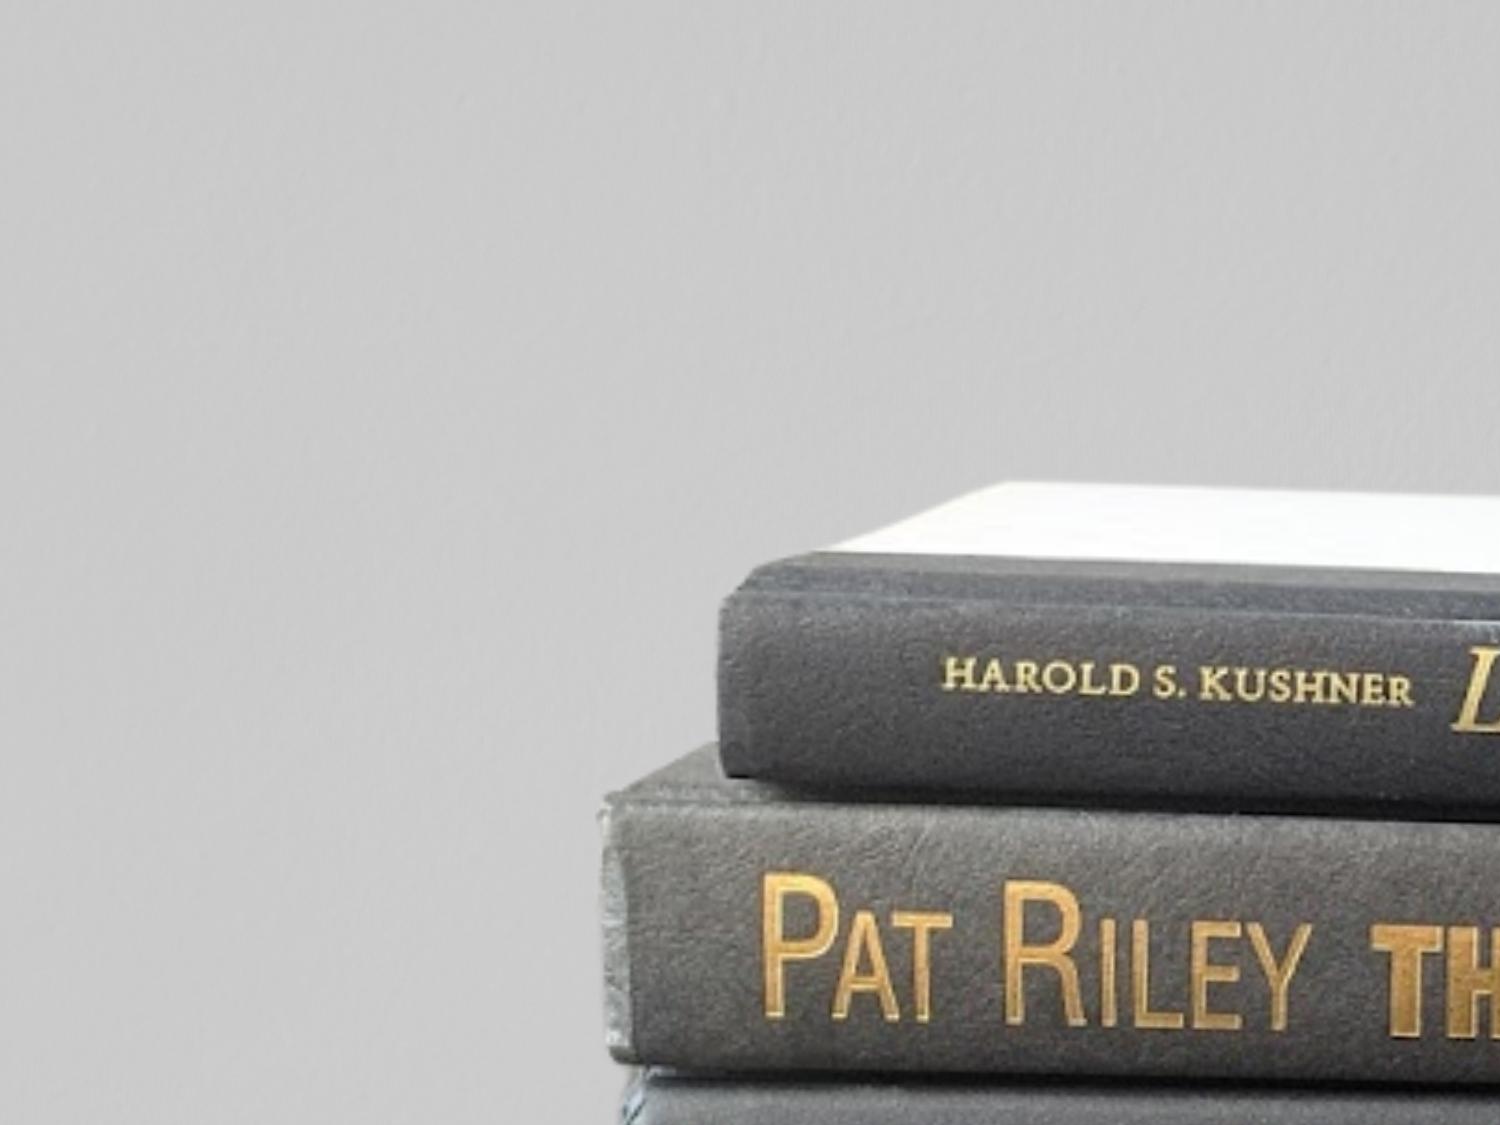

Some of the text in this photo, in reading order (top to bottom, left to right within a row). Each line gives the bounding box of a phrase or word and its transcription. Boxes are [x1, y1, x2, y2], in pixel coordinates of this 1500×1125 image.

[940, 655, 1414, 707] HAROLD S. KUSHNER
